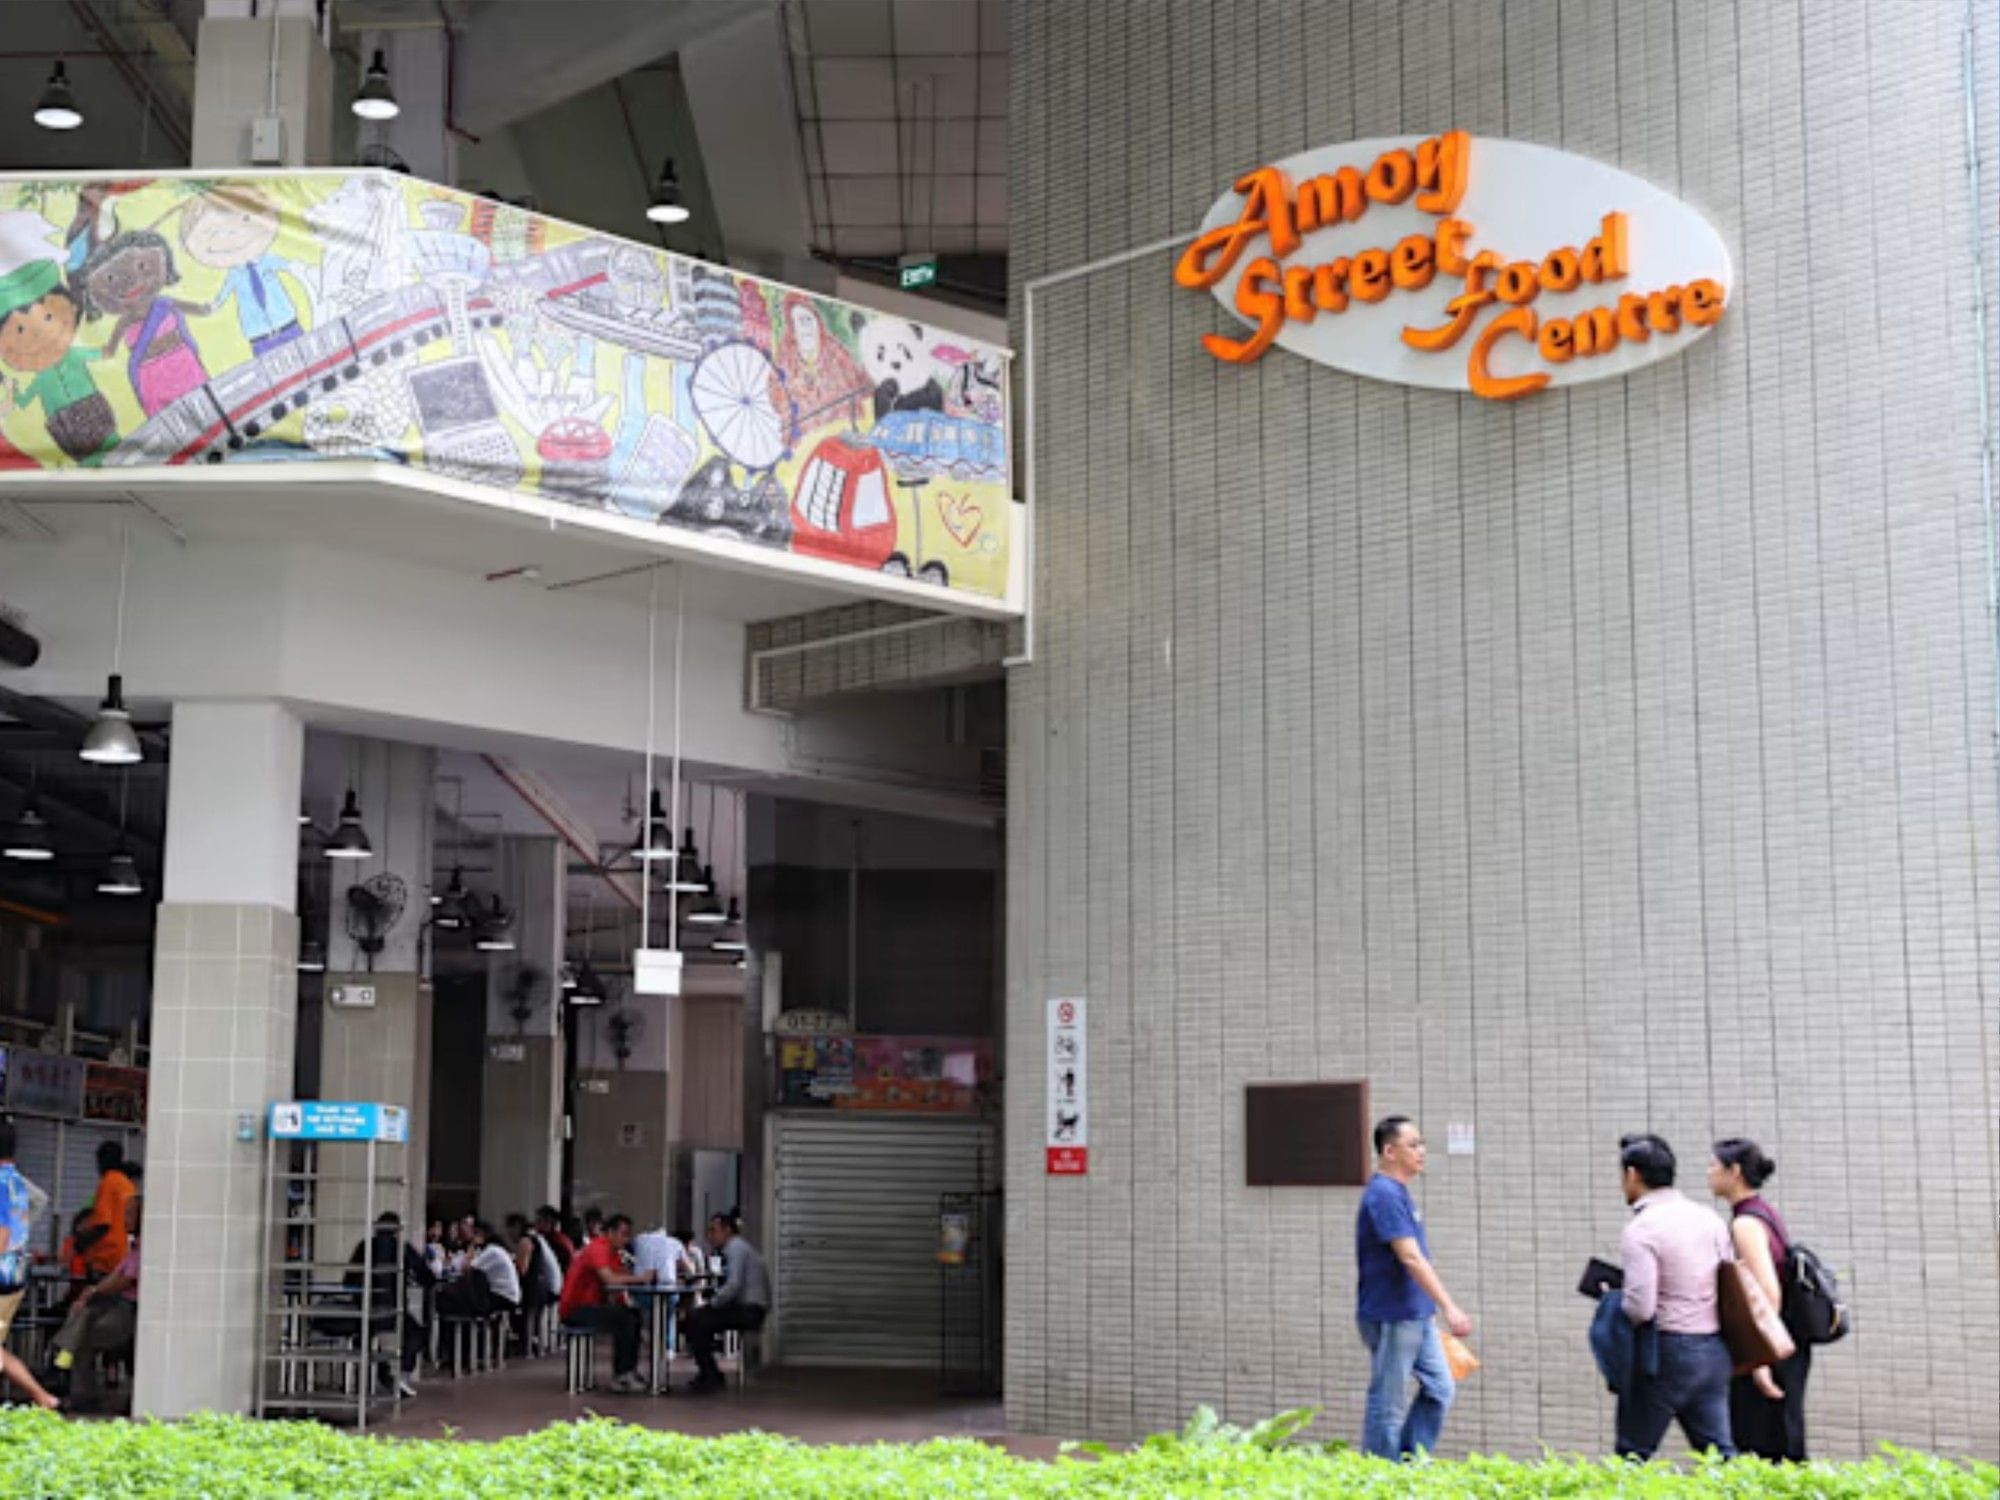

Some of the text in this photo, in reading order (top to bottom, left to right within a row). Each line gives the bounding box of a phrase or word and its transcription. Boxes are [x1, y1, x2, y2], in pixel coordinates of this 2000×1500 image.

[1174, 129, 1470, 287] Amoy
[1201, 217, 1475, 363] Street
[1468, 278, 1725, 399] Centre
